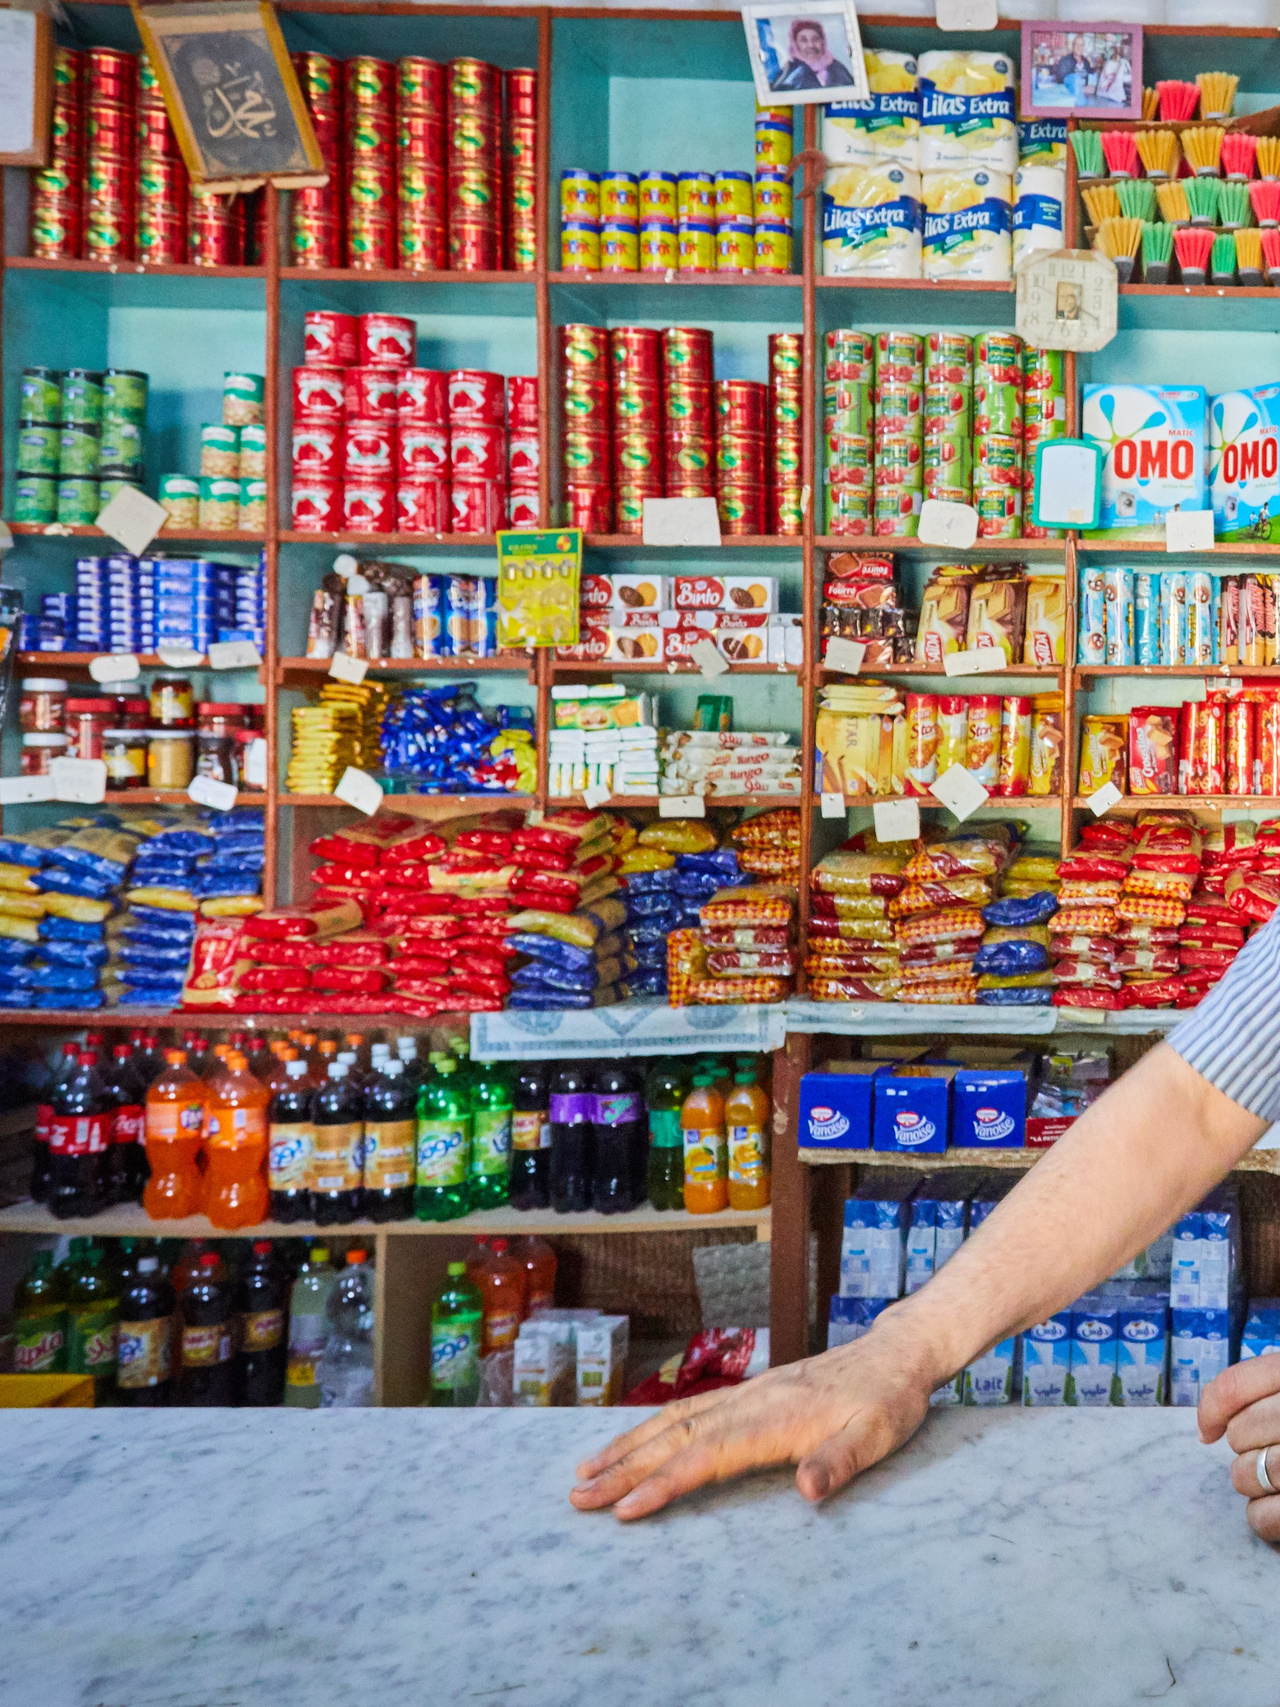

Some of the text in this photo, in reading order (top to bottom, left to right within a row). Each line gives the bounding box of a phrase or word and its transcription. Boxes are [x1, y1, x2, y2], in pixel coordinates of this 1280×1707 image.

[880, 96, 918, 113] Extra
[923, 94, 1010, 117] Lilas Extra
[824, 207, 905, 232] Lilas Extra
[924, 214, 951, 237] ilas
[953, 210, 990, 230] Extra
[1168, 429, 1194, 437] MATIC
[1259, 426, 1278, 435] MATIC
[1114, 438, 1194, 480] OMO
[1223, 437, 1278, 484] OMO
[677, 577, 720, 605] Binto
[1137, 727, 1151, 778] Croustina
[808, 1118, 848, 1137] Vanoise
[894, 1124, 935, 1143] Vanoise
[973, 1119, 1013, 1138] Vanoise
[975, 1377, 1002, 1391] Lait
